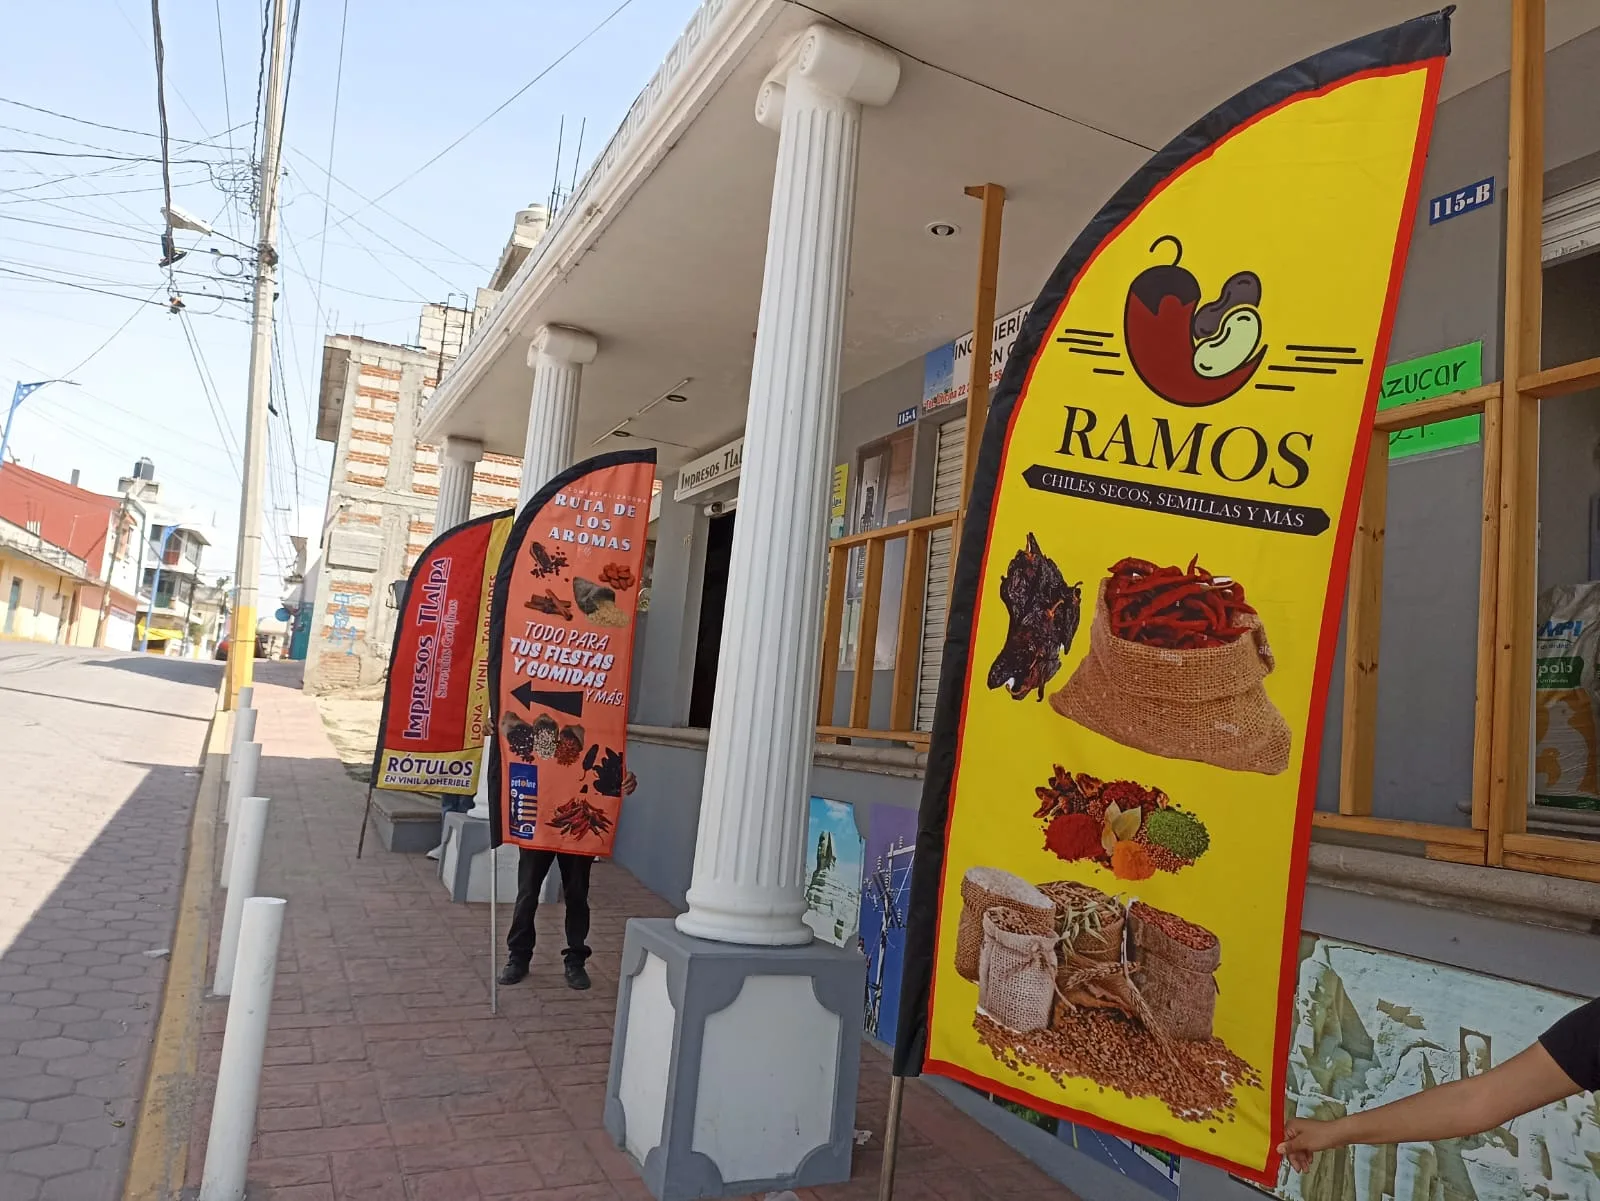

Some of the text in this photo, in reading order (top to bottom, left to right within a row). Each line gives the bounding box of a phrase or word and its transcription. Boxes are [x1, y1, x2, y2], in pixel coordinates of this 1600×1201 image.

[1432, 182, 1490, 220] 115-B
[1055, 405, 1314, 489] RAMOS
[554, 493, 637, 518] RUTA DE
[1041, 472, 1305, 528] CHILES SECOS, SEMILLAS Y MÁS
[575, 514, 612, 531] LOS
[548, 526, 632, 552] AROMAS
[525, 621, 610, 650] TODO PARA
[510, 637, 616, 671] TUS FIESTAS
[475, 657, 489, 692] VINIL
[513, 656, 608, 689] Y COMIDAS
[585, 688, 595, 704] Y
[470, 703, 483, 740] LONA
[386, 753, 473, 777] RÓTULOS
[384, 774, 471, 788] EN VINIL ADHERIBLE
